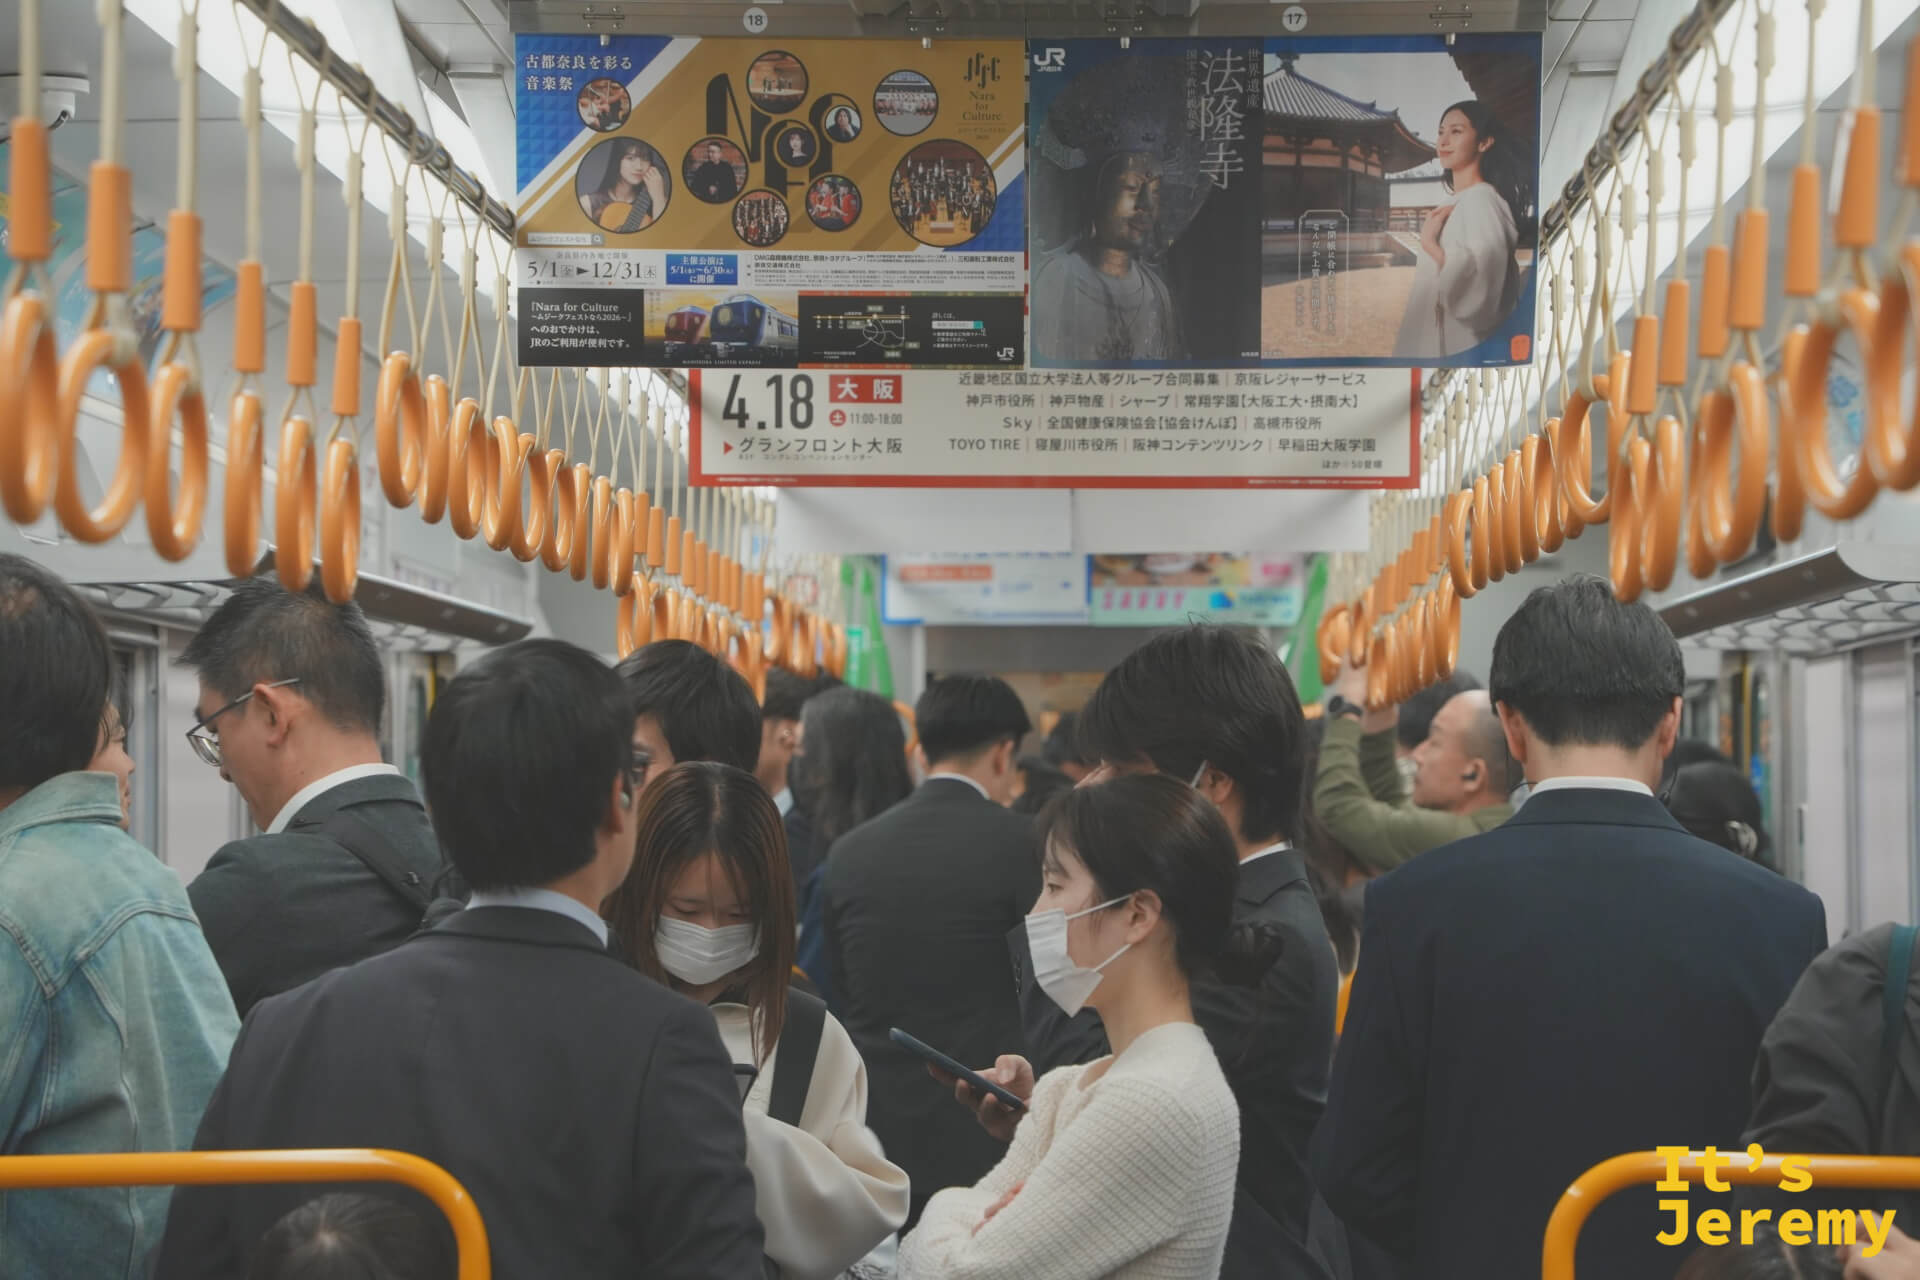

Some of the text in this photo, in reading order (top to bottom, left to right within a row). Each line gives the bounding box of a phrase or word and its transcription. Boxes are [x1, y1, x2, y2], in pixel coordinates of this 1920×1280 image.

[747, 14, 763, 26] 18
[1287, 13, 1303, 25] 17
[526, 54, 633, 70] 古都奈良を彩る
[1034, 47, 1066, 66] JR
[526, 75, 573, 91] 音楽祭
[969, 90, 996, 101] Nara
[975, 103, 989, 111] for
[962, 111, 1002, 121] Culture
[1199, 48, 1246, 190] 法隆寺
[682, 256, 724, 265] 主催公演は
[689, 274, 715, 283] に開催
[563, 302, 578, 312] for
[581, 302, 619, 312] Culture
[530, 325, 601, 335] へのおでかけは、
[529, 337, 631, 348] JRのご利用が便利です。
[996, 347, 1015, 358] JR
[959, 372, 1367, 386] 近畿地区国立大学法人等グループ合同募集 京阪レジャーサービス
[837, 378, 895, 400] 大阪
[722, 374, 814, 430] 4.18
[966, 394, 1359, 409] 神戸市役所 神戸物産 シャープ 常翔学園【大阪工大・摂南大】
[830, 410, 903, 426] 土 11:00-18:00
[1002, 416, 1322, 431] Sky 全国健康保険協会【協会けんぽ】 高槻市役所
[739, 437, 903, 454] グランフロント大阪
[949, 438, 1377, 453] TOYO TIRE 寝屋川市役所 阪神コンテンツリンク 早稲田大阪学園
